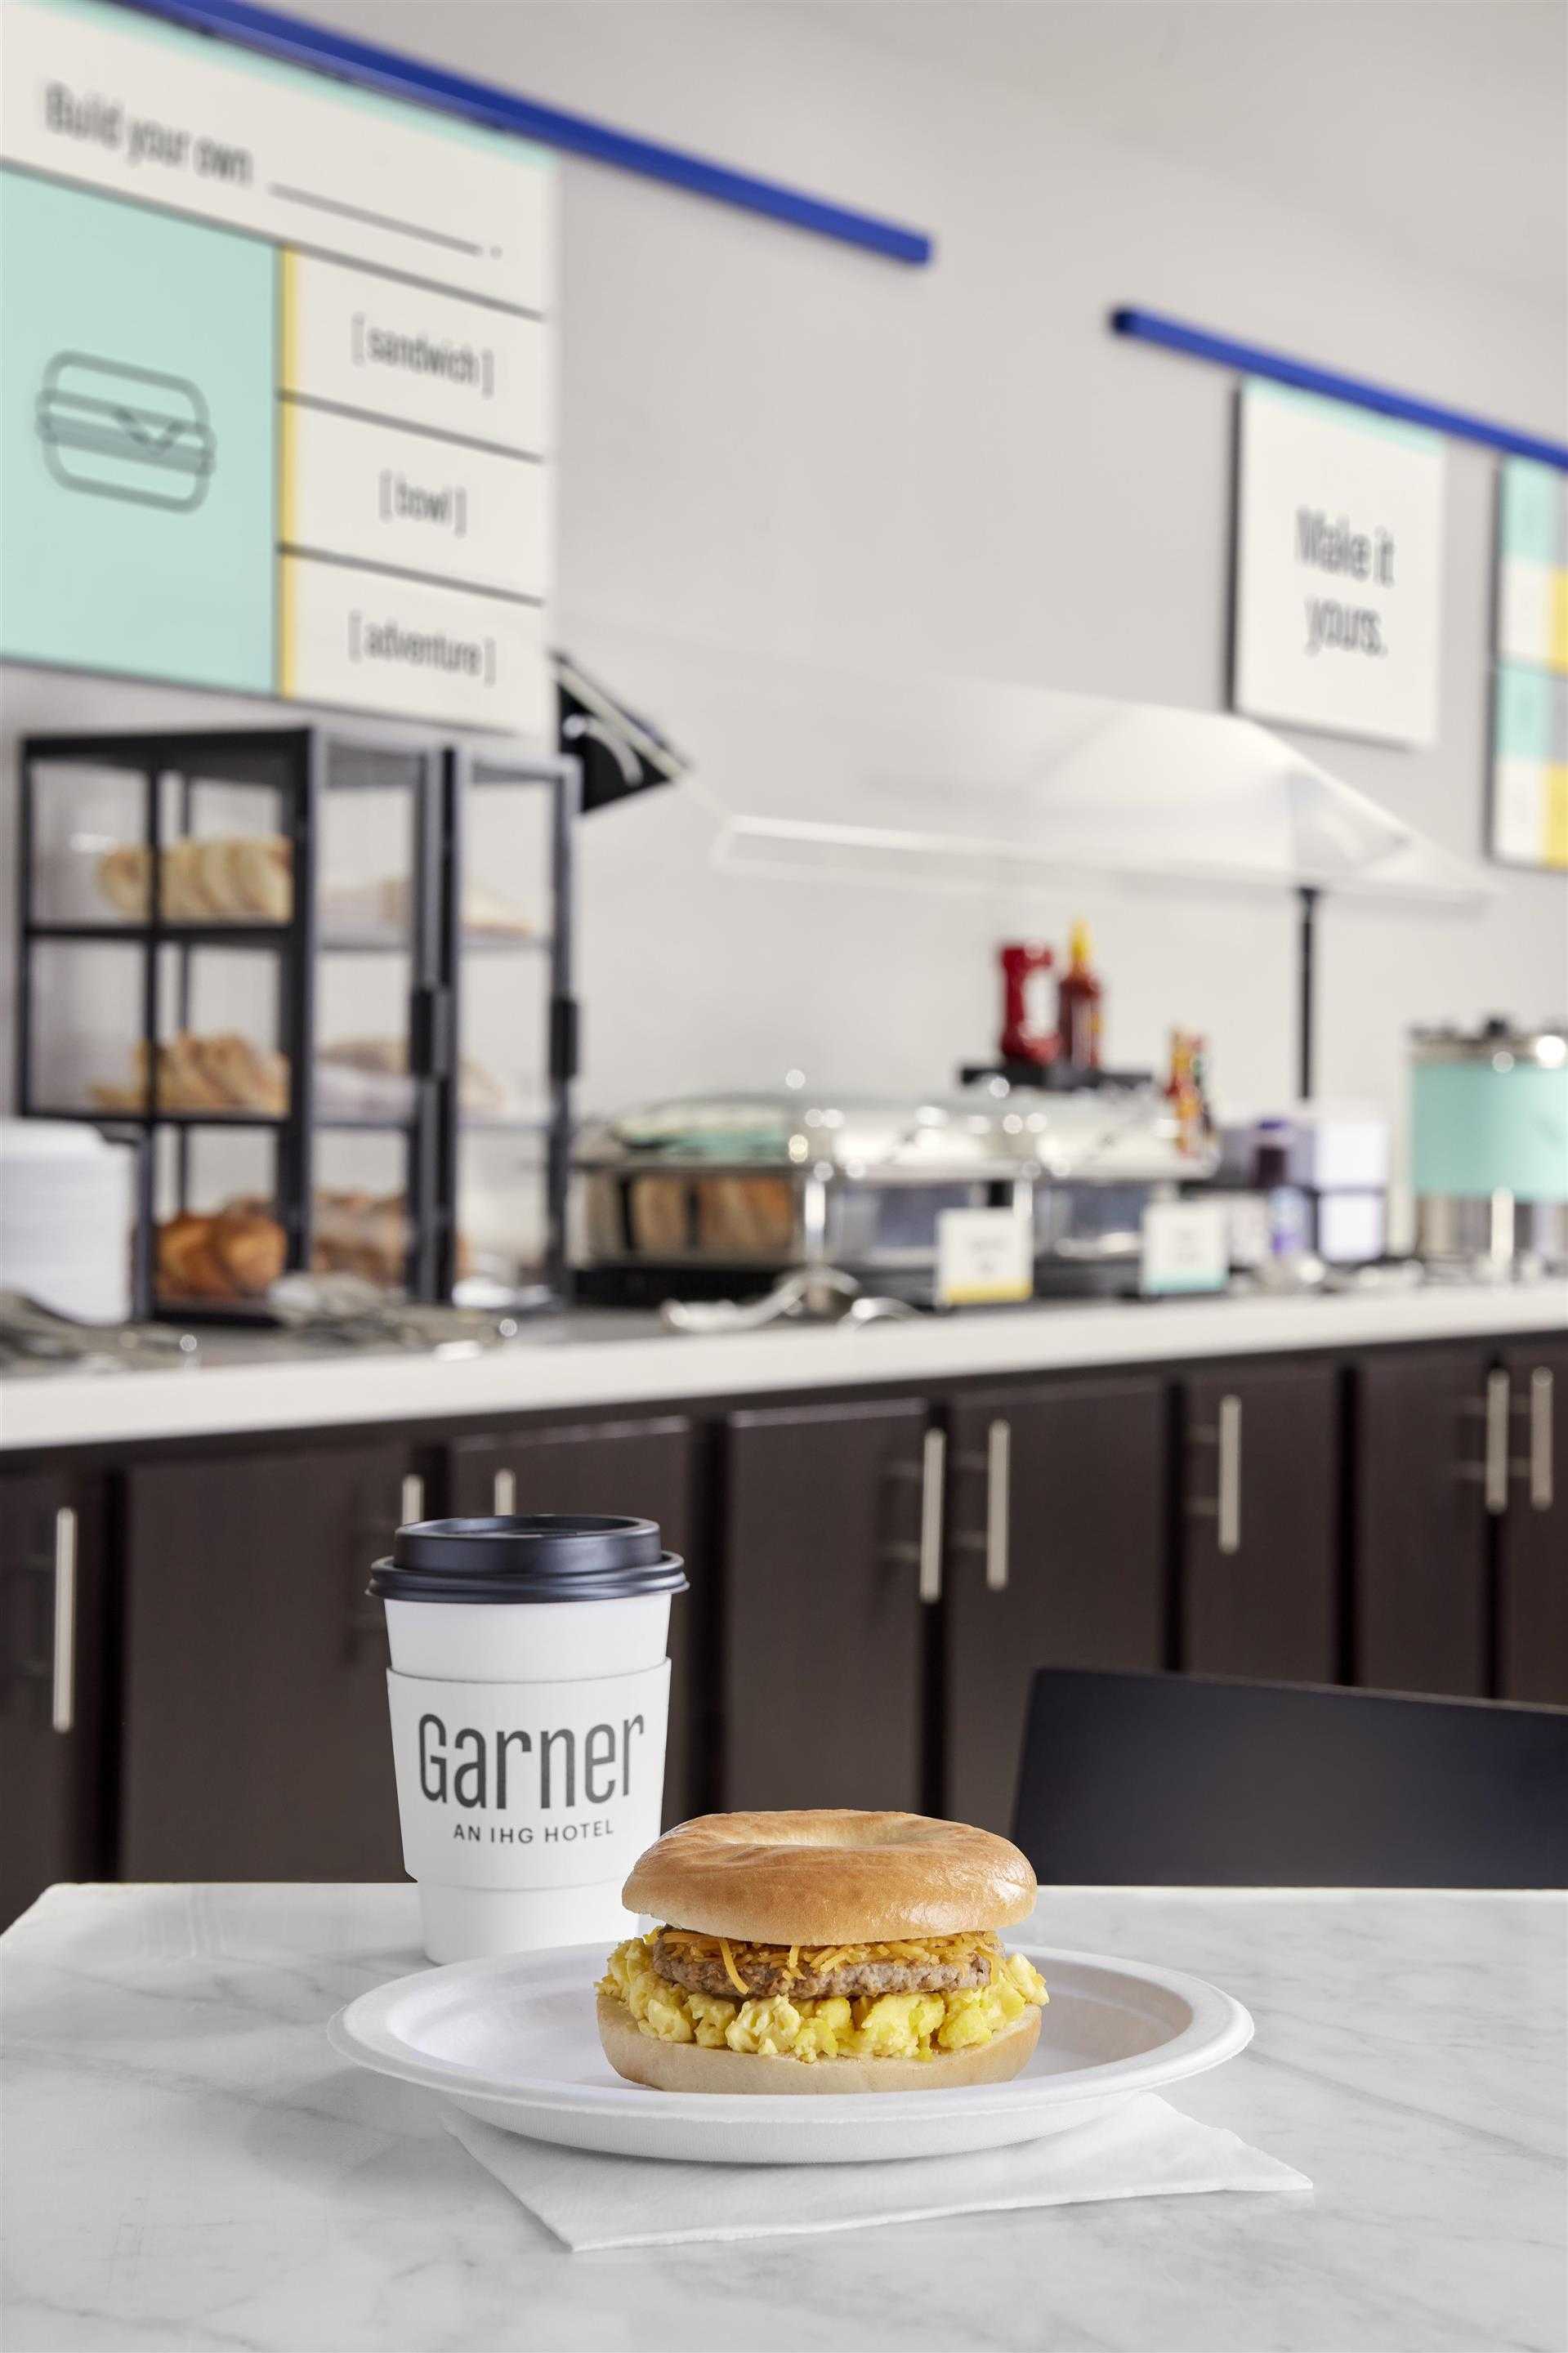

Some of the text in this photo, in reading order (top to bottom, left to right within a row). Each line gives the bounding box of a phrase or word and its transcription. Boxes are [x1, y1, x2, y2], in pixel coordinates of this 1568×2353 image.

[44, 79, 252, 188] Build your own
[1296, 505, 1396, 589] Make it
[418, 1713, 645, 1810] Garner
[453, 1819, 614, 1844] AN IHG HOTEL
